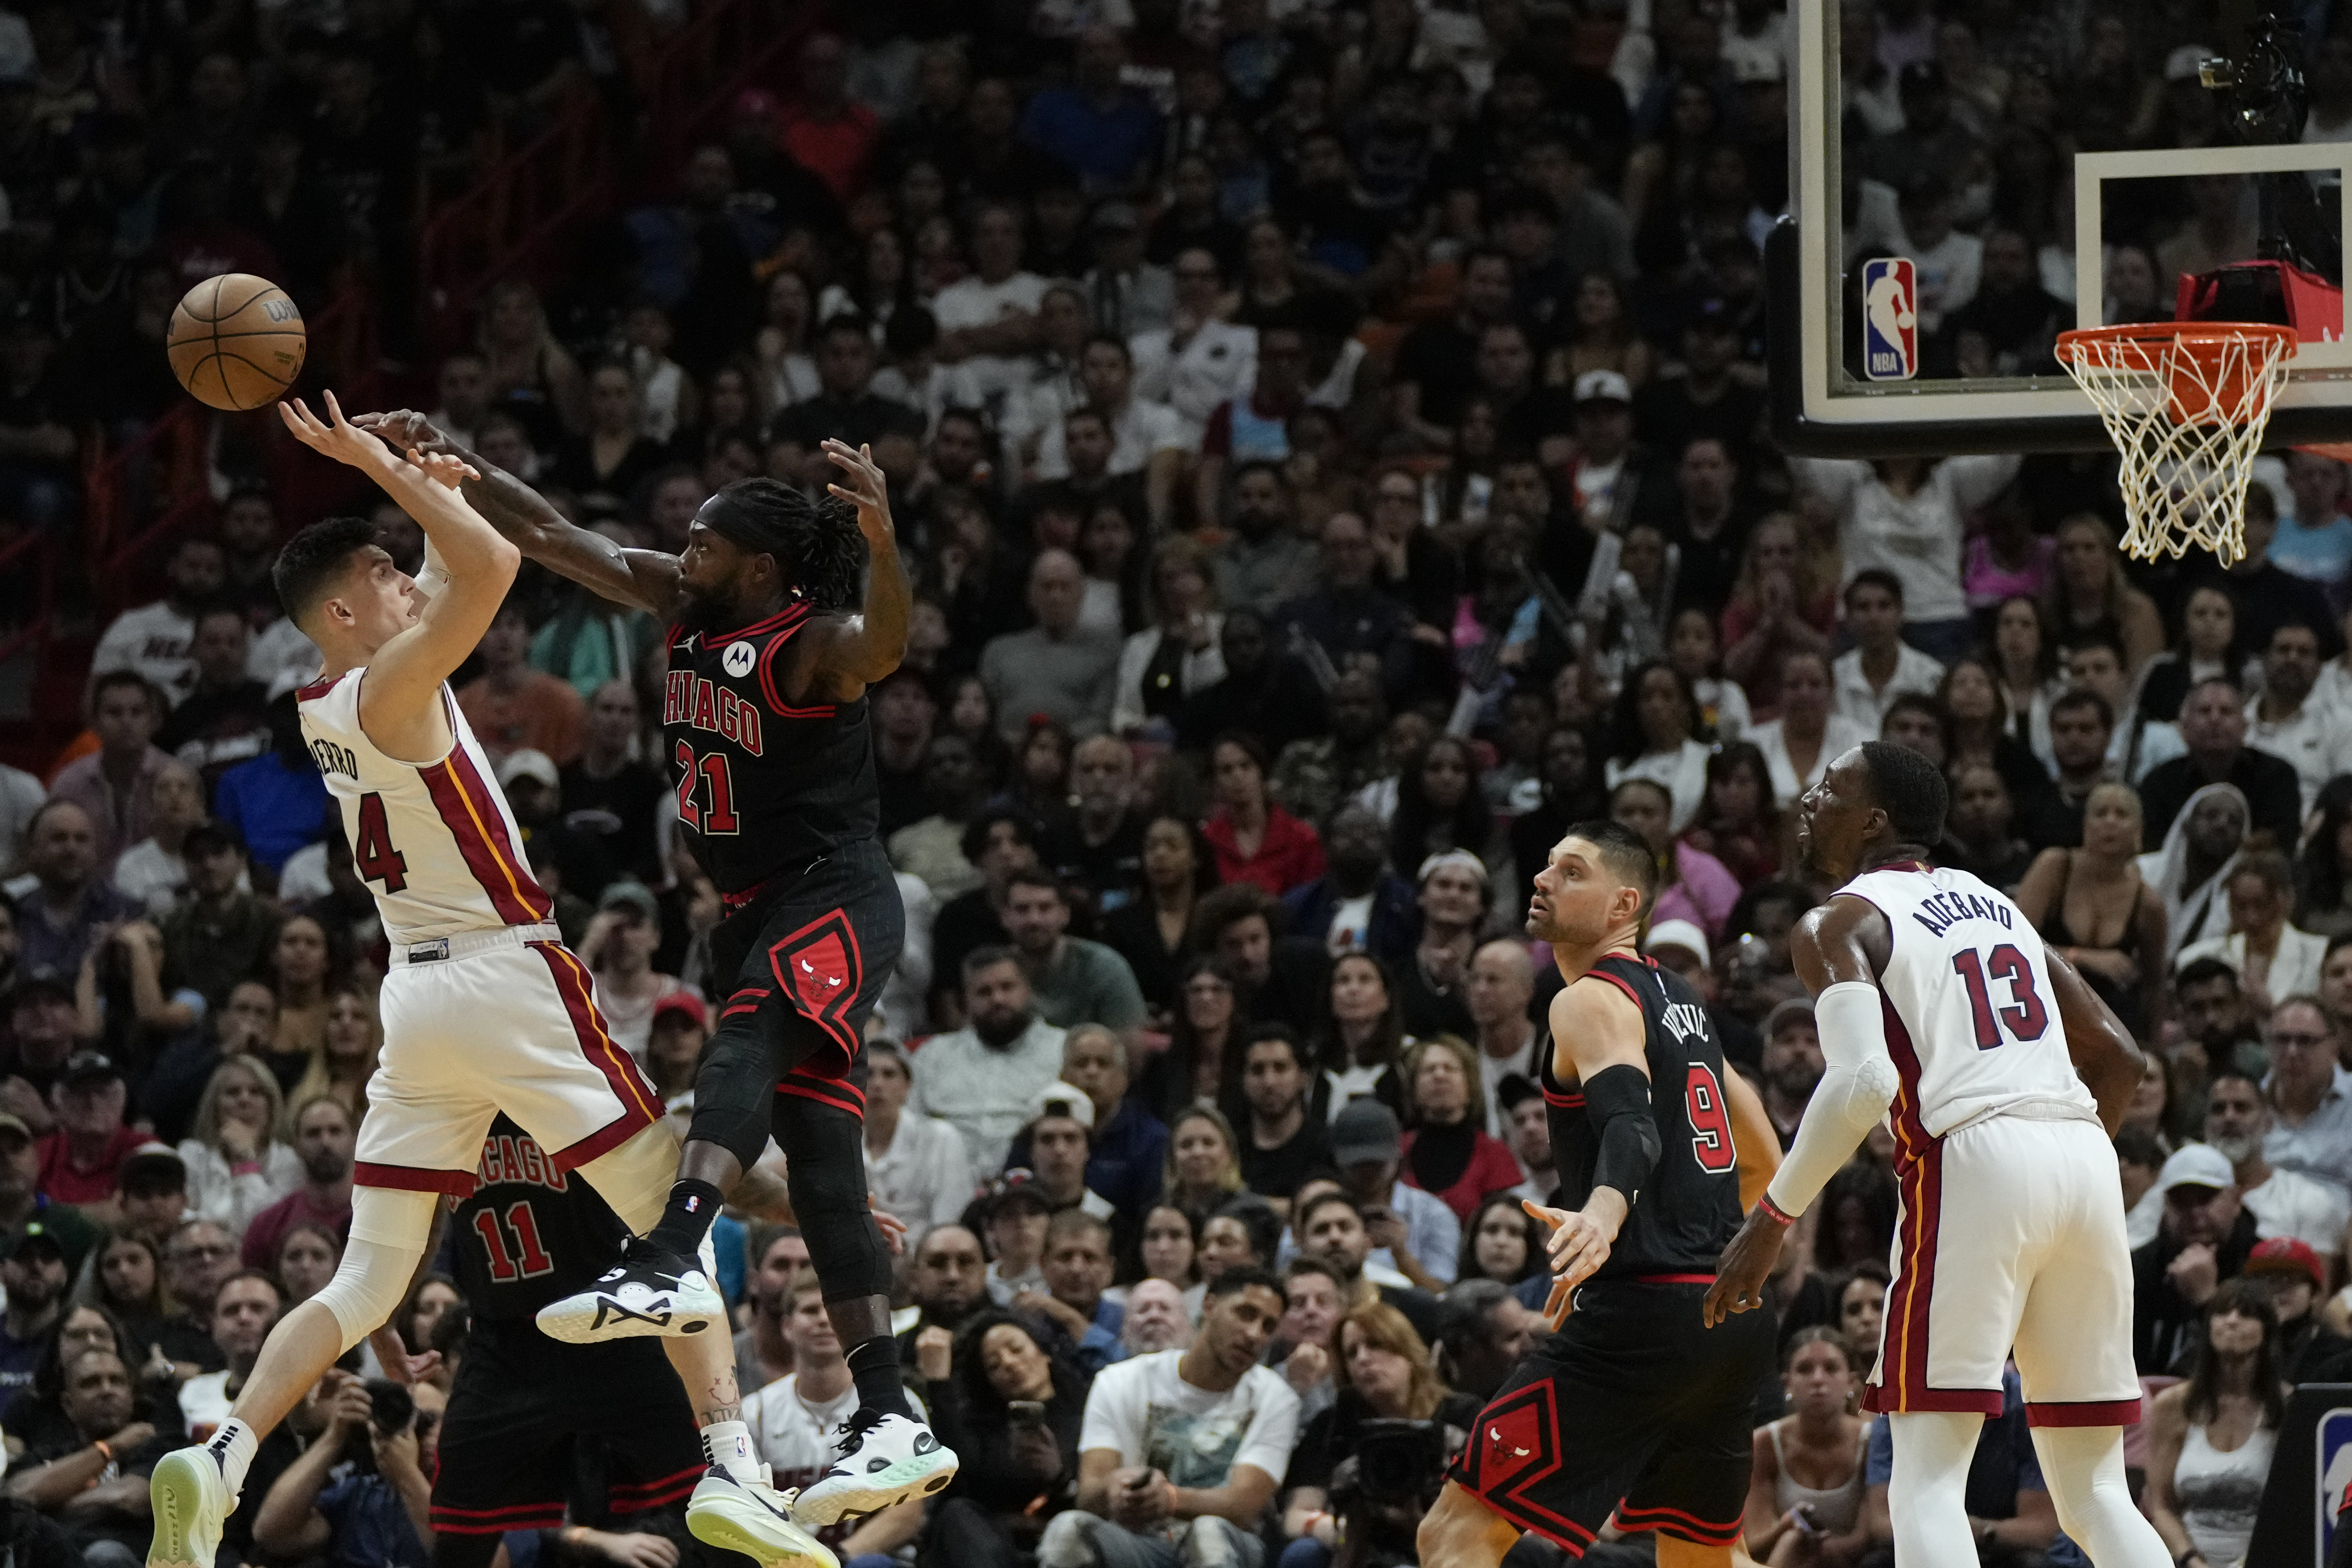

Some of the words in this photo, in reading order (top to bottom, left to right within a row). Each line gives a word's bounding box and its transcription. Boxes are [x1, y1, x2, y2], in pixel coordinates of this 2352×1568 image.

[1872, 352, 1898, 372] NBA
[663, 669, 763, 757] HIAGO
[675, 738, 740, 835] 21
[356, 791, 408, 895] 4
[1913, 891, 2012, 938] ADEBAYO
[1952, 943, 2049, 1051] 13
[1685, 1061, 1737, 1174] 9
[472, 1200, 555, 1284] 11
